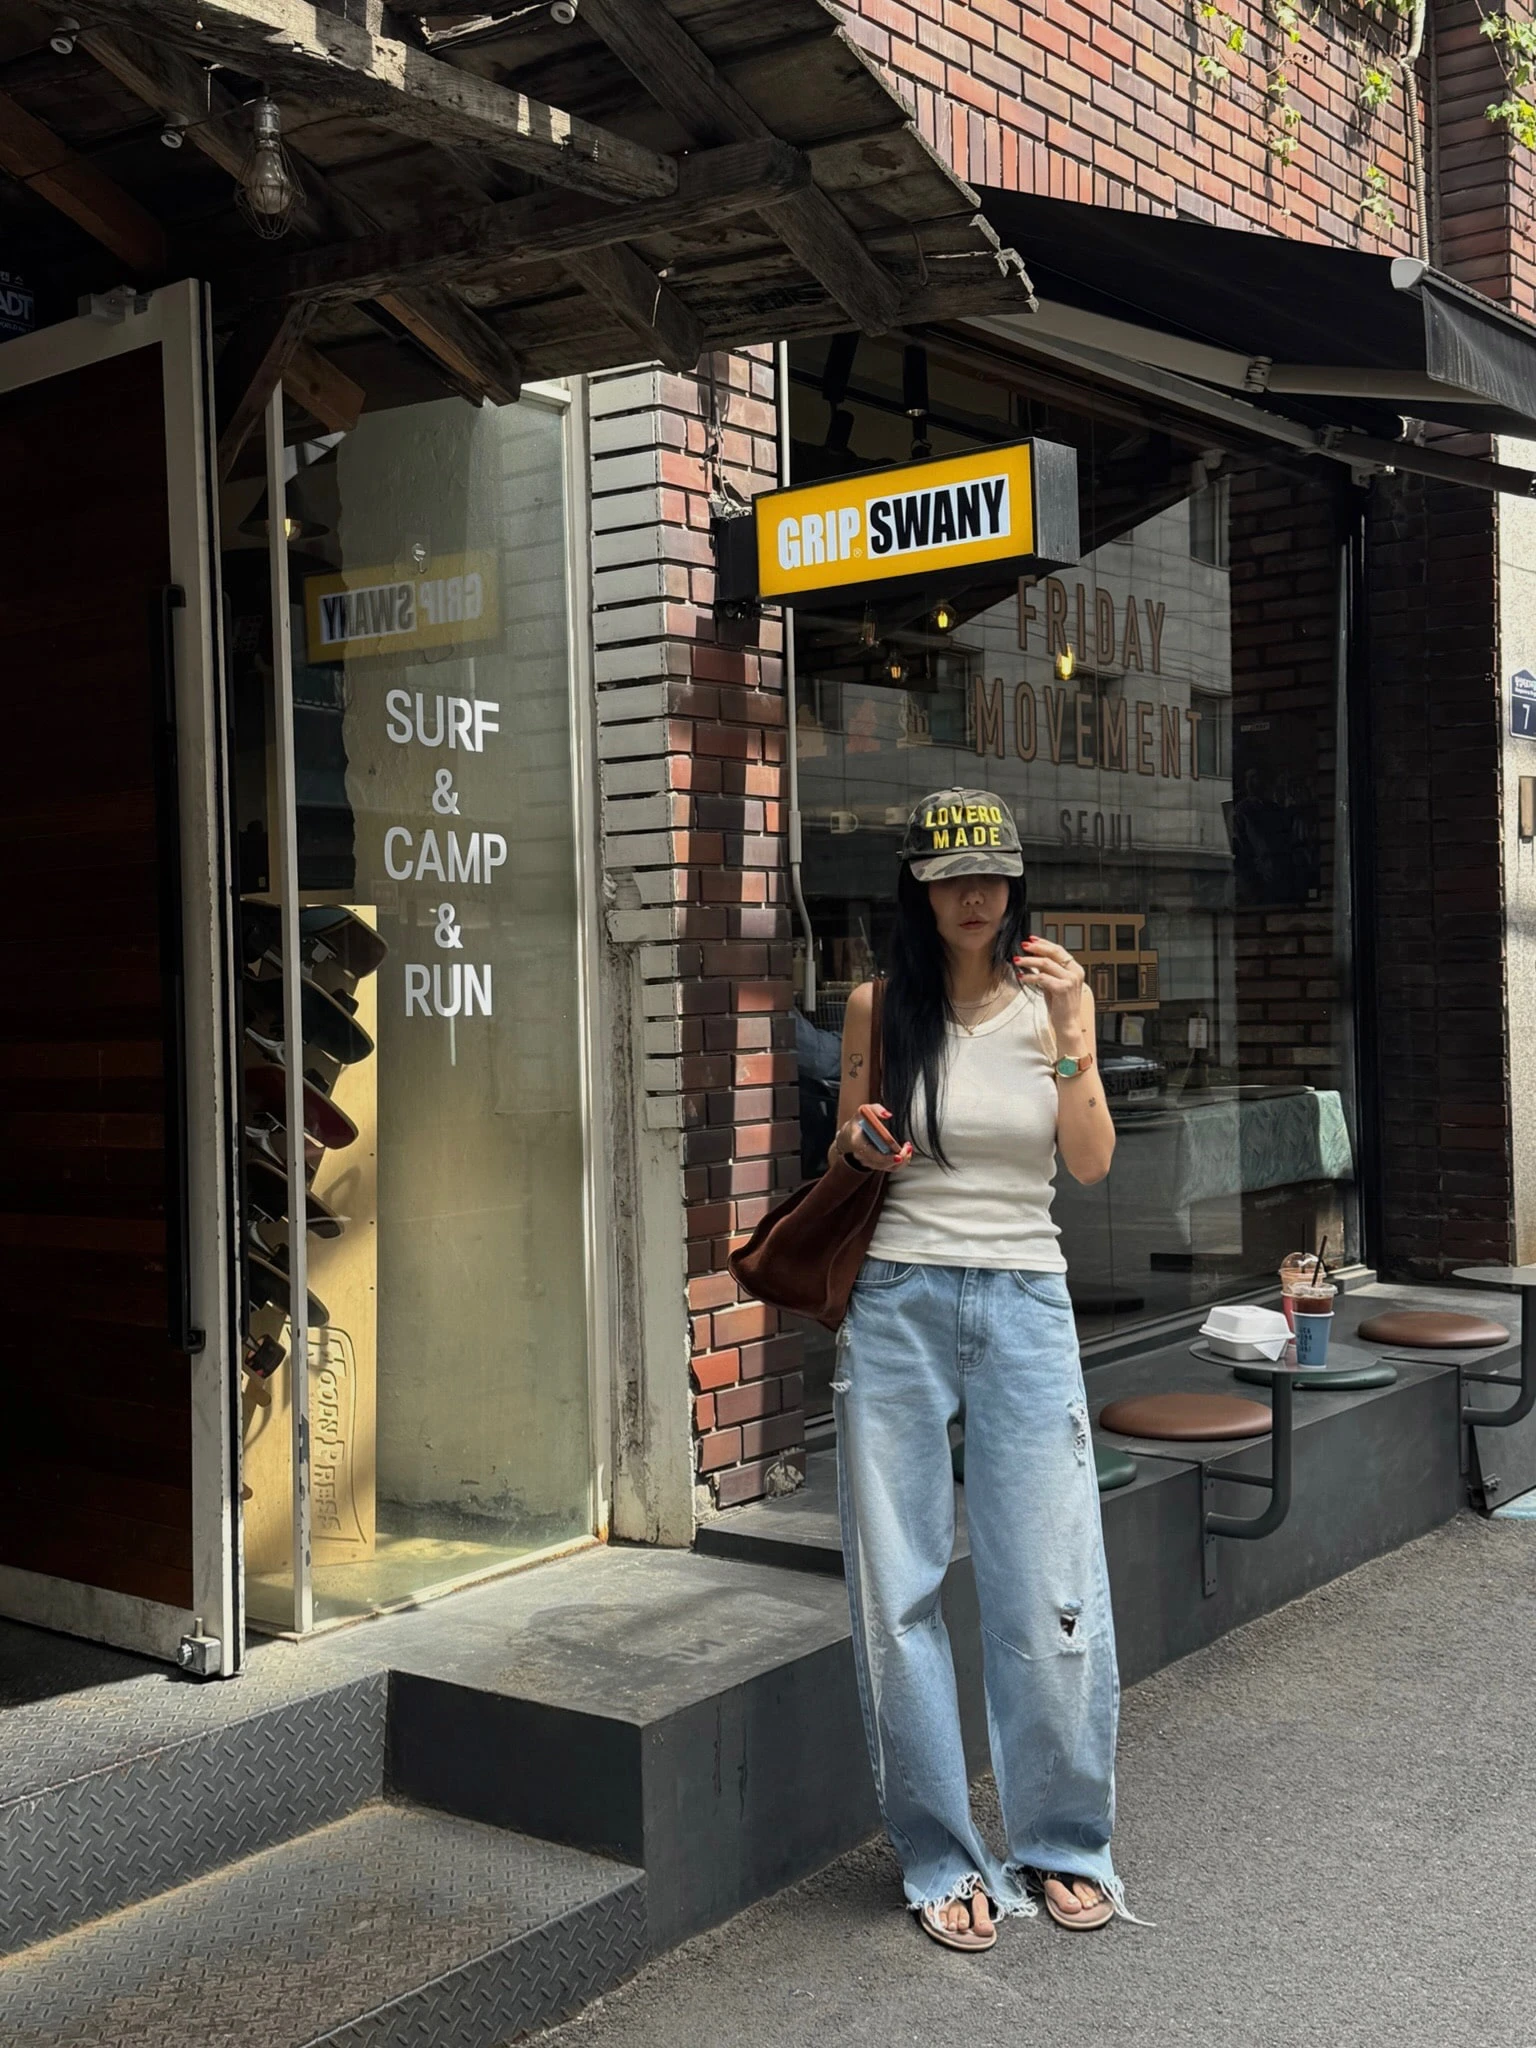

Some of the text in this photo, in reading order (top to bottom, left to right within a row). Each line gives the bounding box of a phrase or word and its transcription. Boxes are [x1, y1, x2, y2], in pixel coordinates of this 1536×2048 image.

[777, 478, 1006, 570] GRIP SWANY
[1017, 574, 1166, 675] FRIDAY
[385, 688, 500, 752] SURF
[974, 673, 1202, 782] MOVEMENT
[1522, 703, 1531, 731] 7
[431, 768, 461, 815] &
[925, 805, 1003, 828] LOVERO
[933, 826, 1002, 849] MADE
[1060, 809, 1136, 850] SEOUL
[383, 826, 508, 885] CAMP
[434, 902, 464, 950] &
[404, 963, 493, 1018] RUN
